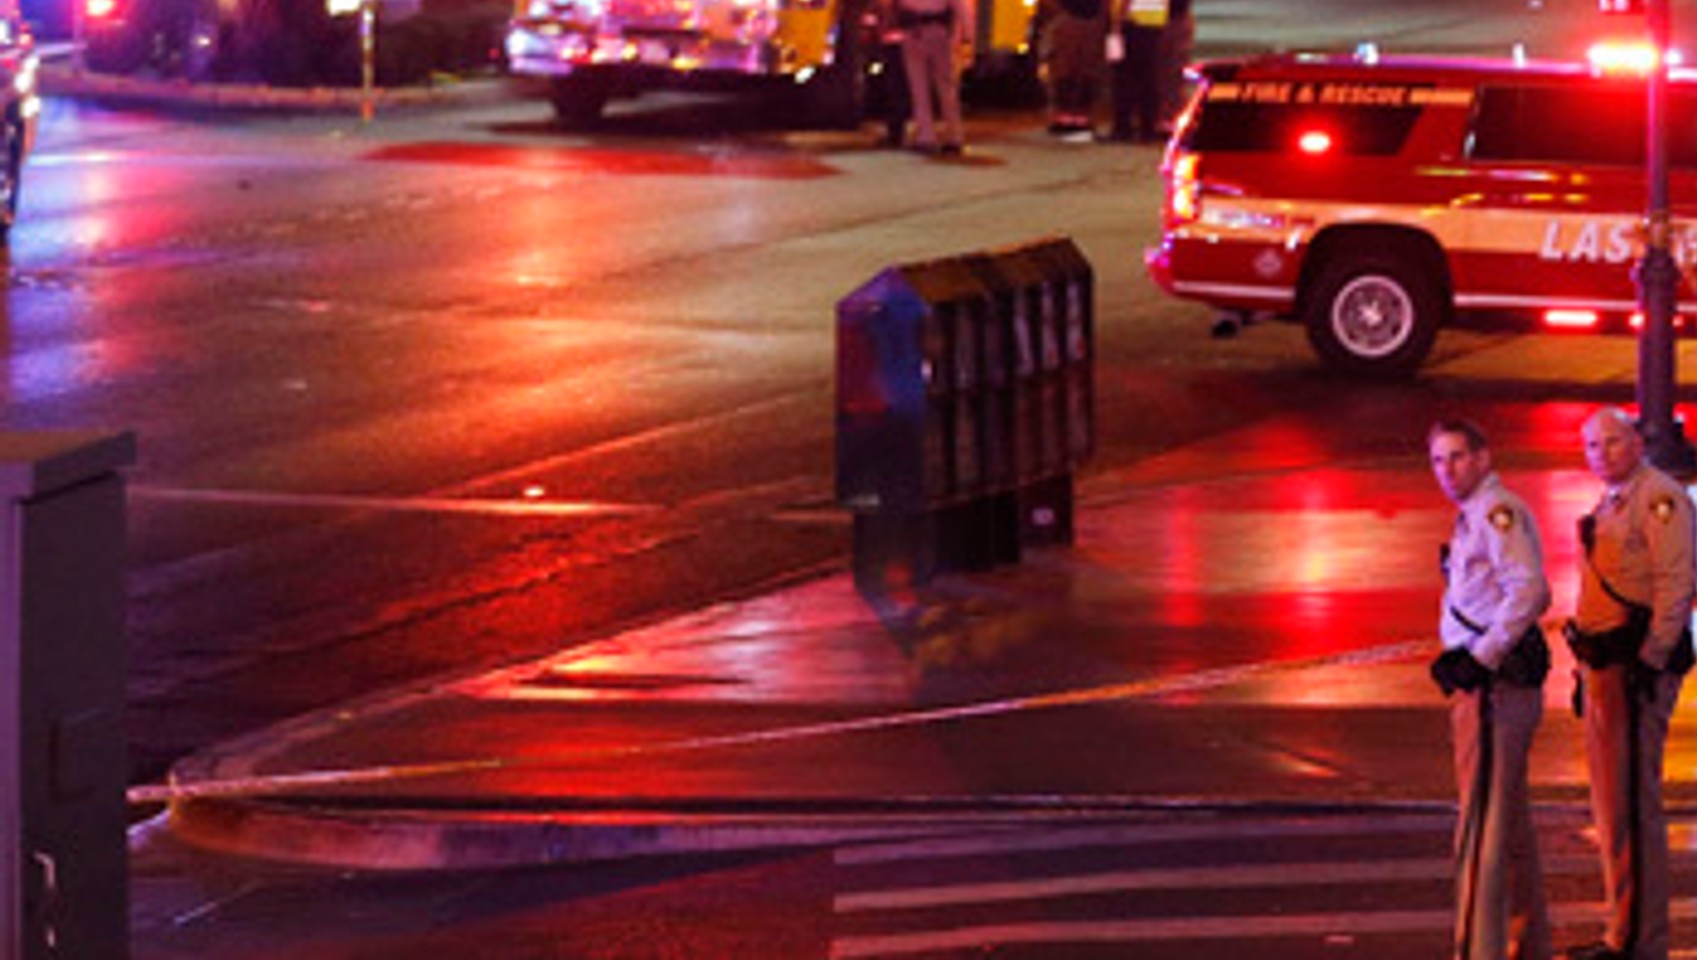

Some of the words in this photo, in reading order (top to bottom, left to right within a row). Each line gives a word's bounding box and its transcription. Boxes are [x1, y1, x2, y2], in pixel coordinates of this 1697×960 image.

[1241, 82, 1292, 104] FIRE
[1296, 84, 1315, 103] &
[1318, 86, 1408, 106] RESCUE
[1539, 218, 1634, 263] LAS
